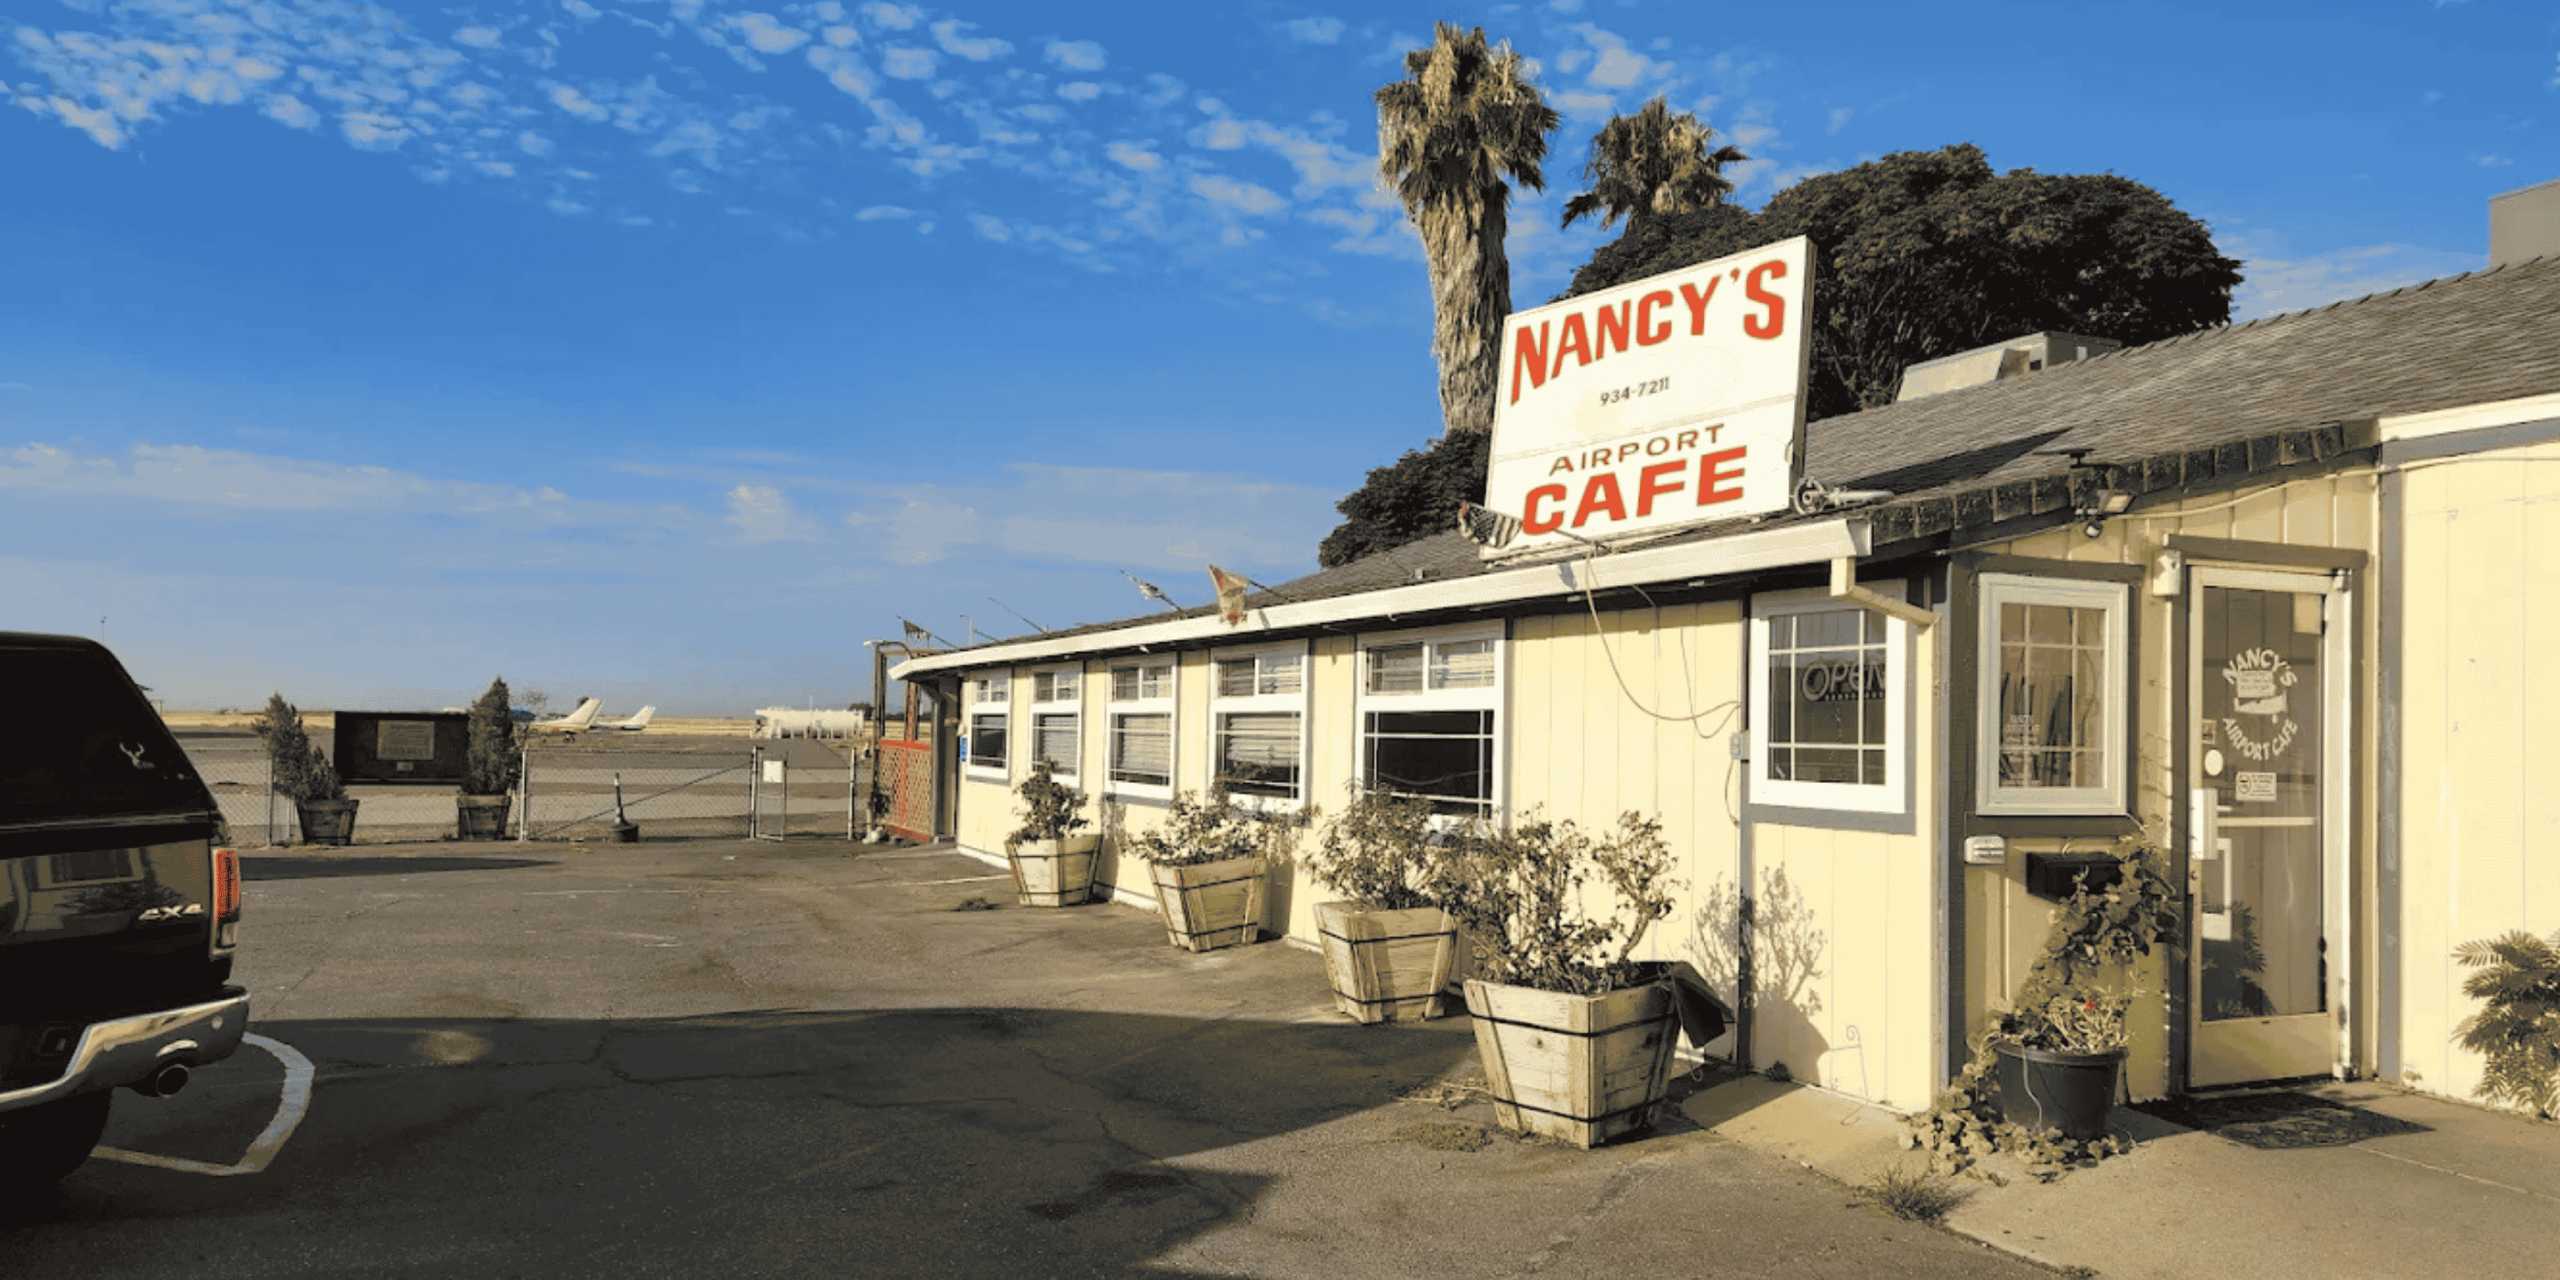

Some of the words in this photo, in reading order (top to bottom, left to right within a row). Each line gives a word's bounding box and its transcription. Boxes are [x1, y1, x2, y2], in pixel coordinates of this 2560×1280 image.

[1510, 259, 1788, 407] NANCY'S
[1599, 375, 1670, 407] 934-7211
[1549, 423, 1725, 476] AIRPORT
[1521, 444, 1747, 536] CAFE
[2222, 647, 2298, 687] NANCY'S
[2222, 718, 2270, 761] AIRPORT
[2272, 718, 2298, 756] CAFE
